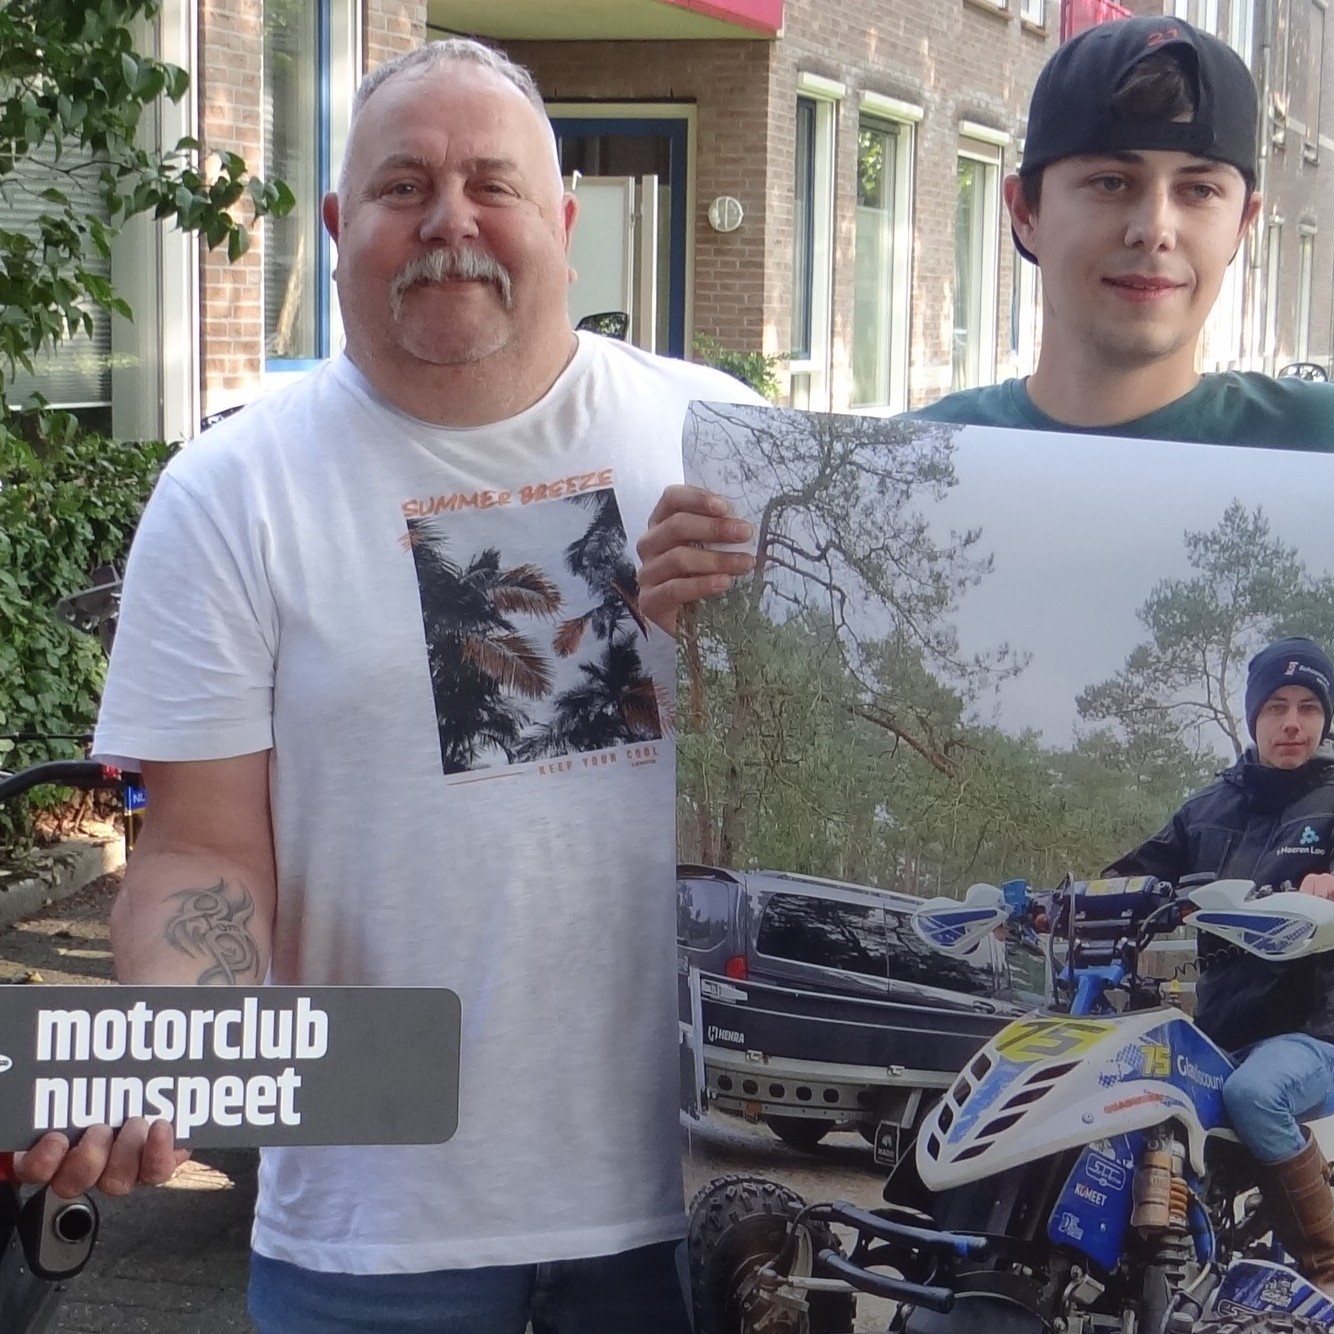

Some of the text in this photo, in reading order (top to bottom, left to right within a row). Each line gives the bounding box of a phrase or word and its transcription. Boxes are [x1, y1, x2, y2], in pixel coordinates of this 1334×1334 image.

[402, 468, 614, 518] SUMMER BREEZE
[538, 760, 573, 775] KEEP
[582, 753, 617, 767] YOUR
[627, 745, 659, 759] COOL
[133, 793, 146, 804] NL
[37, 997, 329, 1061] motorclub
[718, 1029, 745, 1043] HENRA
[1140, 1045, 1172, 1077] 75
[34, 1067, 301, 1139] nunspeet
[1074, 1183, 1107, 1206] KOMEET
